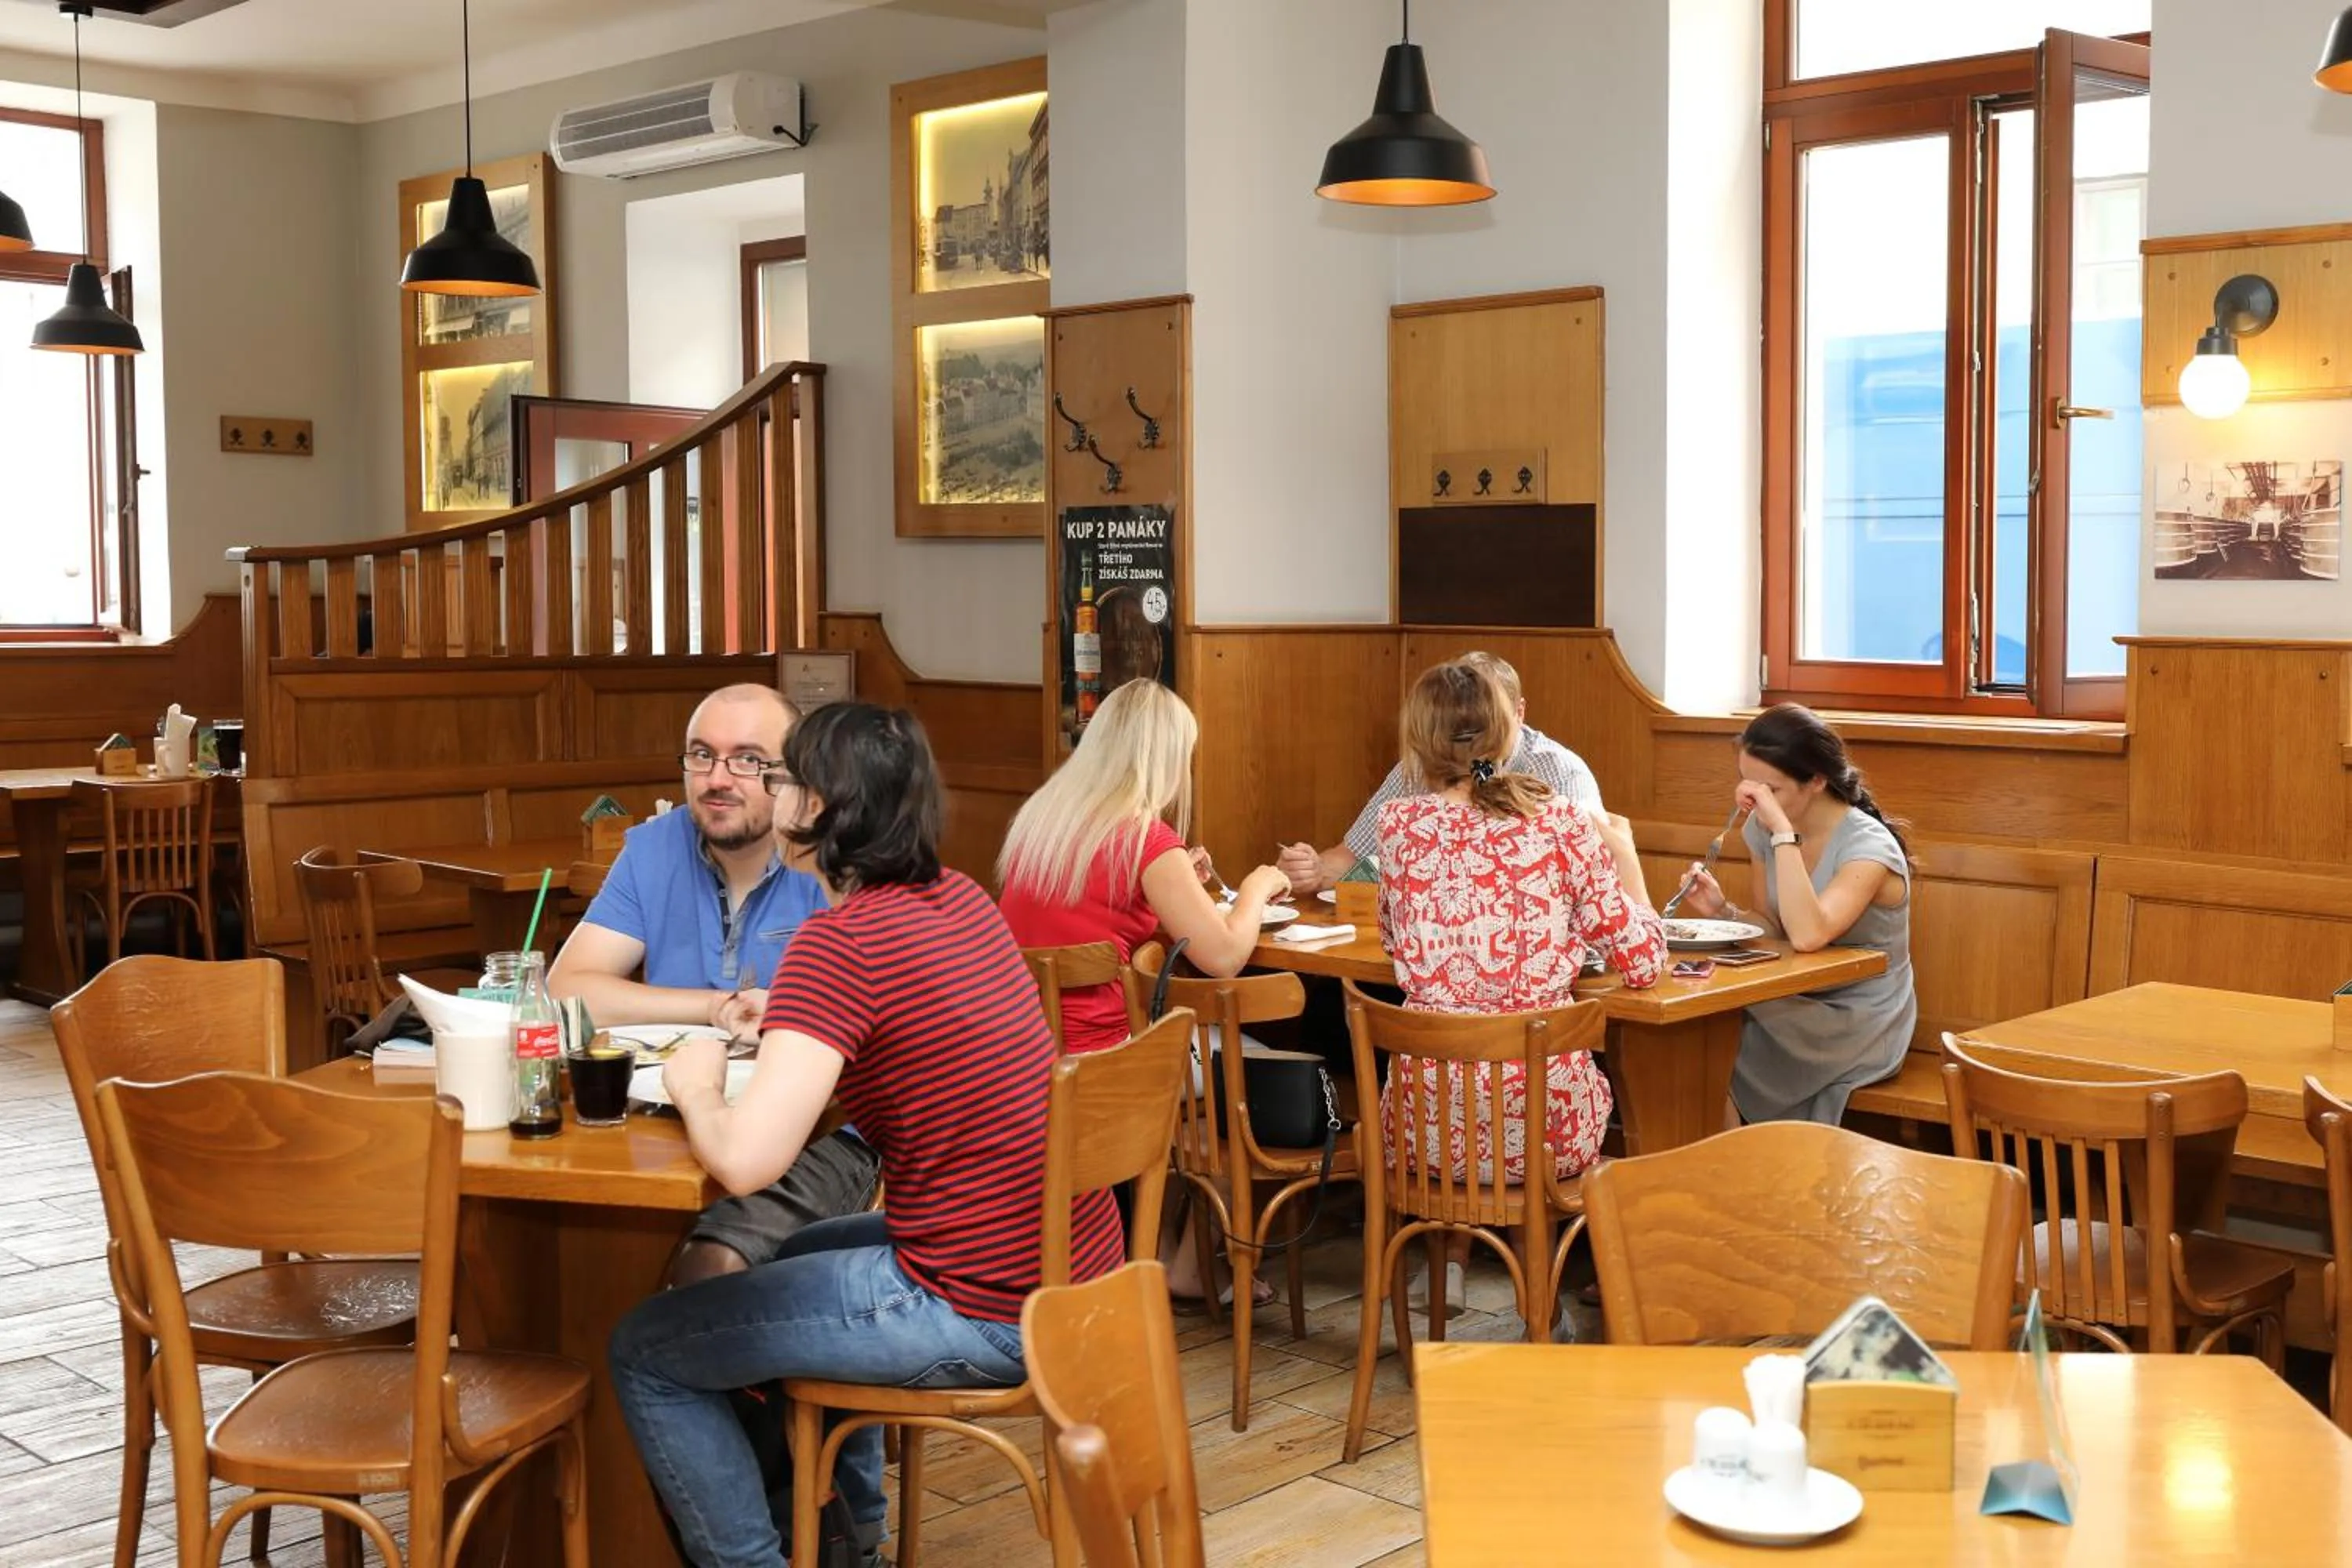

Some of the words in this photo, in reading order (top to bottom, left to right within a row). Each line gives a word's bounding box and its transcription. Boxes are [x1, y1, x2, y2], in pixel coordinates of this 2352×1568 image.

[1066, 521, 1094, 539] KUP
[1097, 521, 1105, 539] 2
[1108, 516, 1166, 539] PANÁKY
[1098, 550, 1133, 564] TŘETÍHO
[1098, 565, 1128, 579] ZÍSKÁŠ
[1130, 568, 1164, 579] ZDARMA
